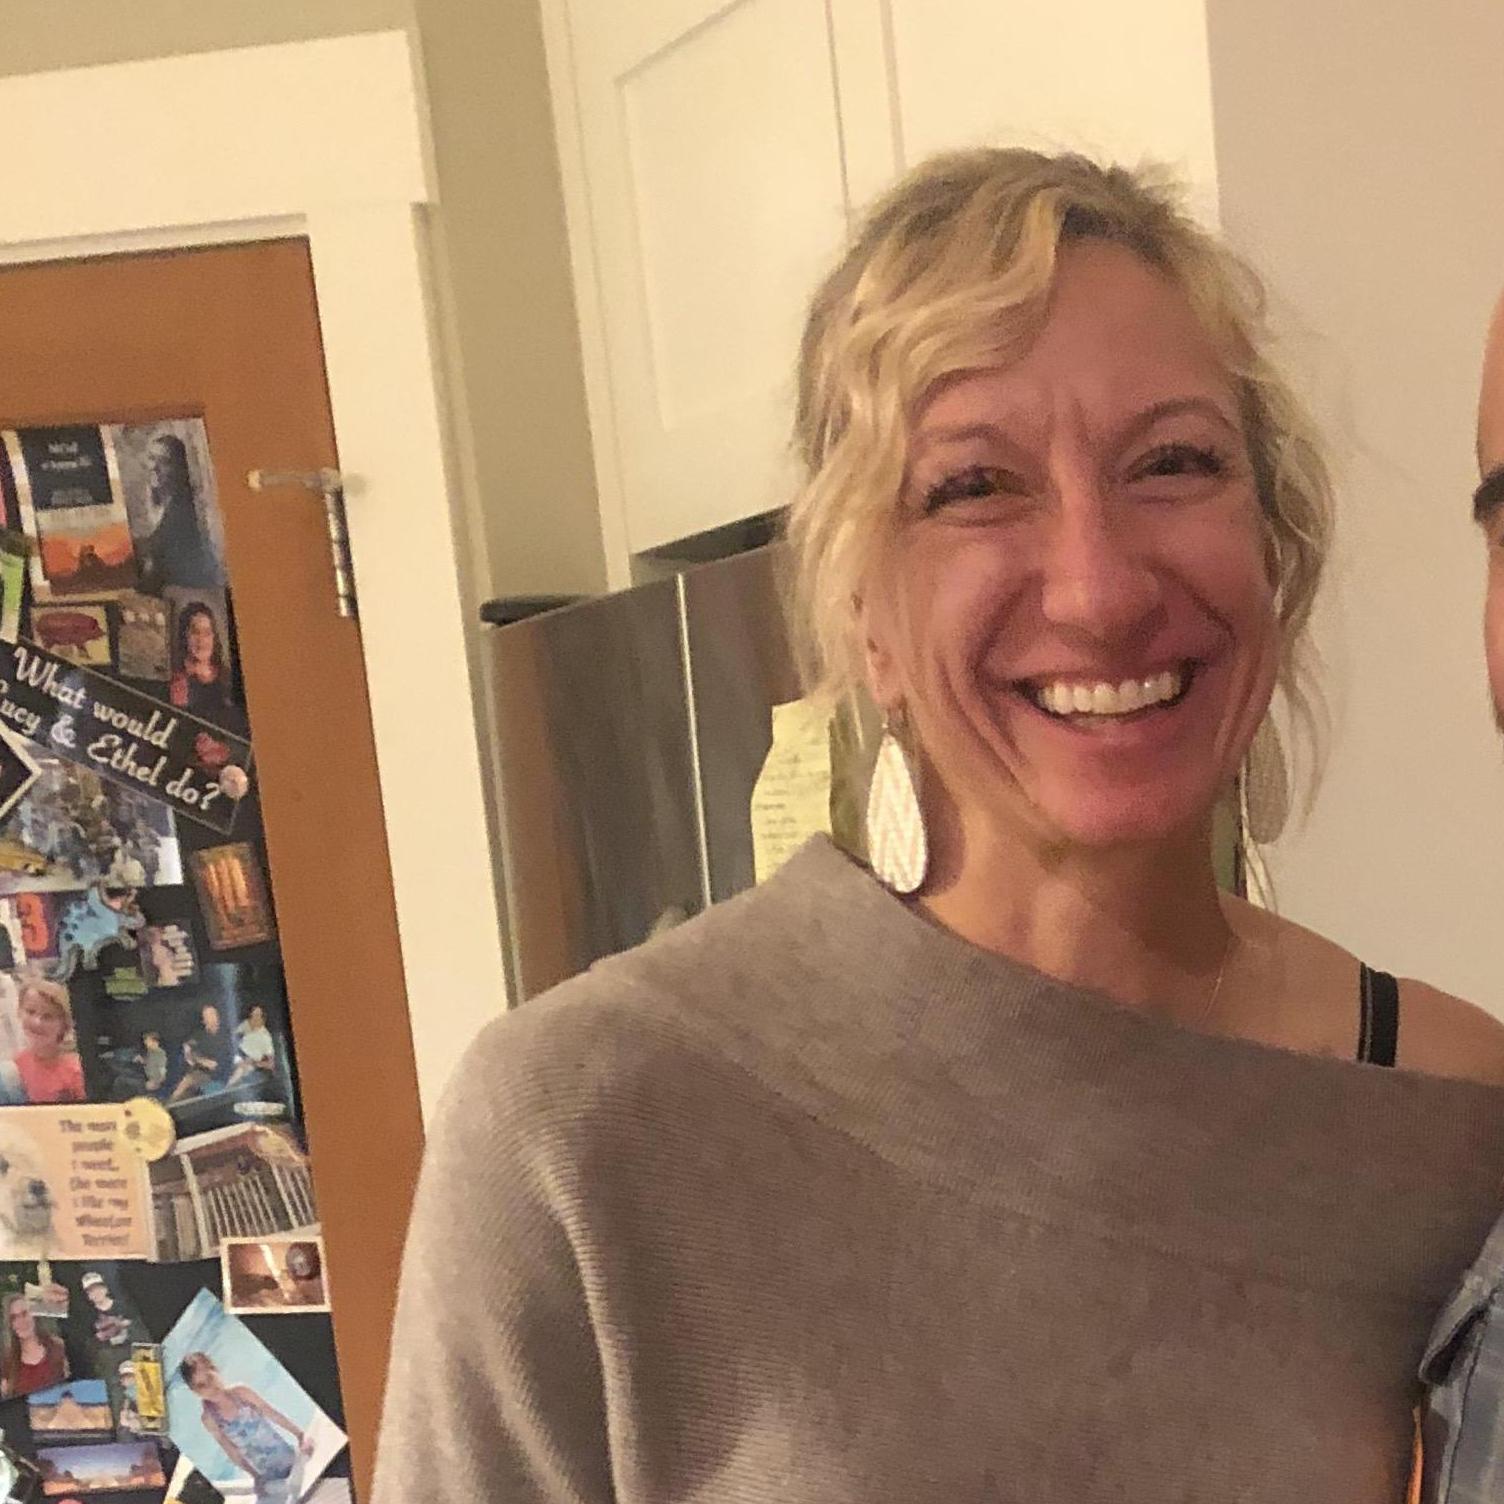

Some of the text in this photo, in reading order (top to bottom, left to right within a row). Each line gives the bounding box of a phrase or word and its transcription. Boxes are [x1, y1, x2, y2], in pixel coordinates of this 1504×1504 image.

[14, 646, 178, 749] What would
[51, 714, 77, 748] &
[87, 734, 167, 786] Ethel
[166, 768, 221, 810] do?
